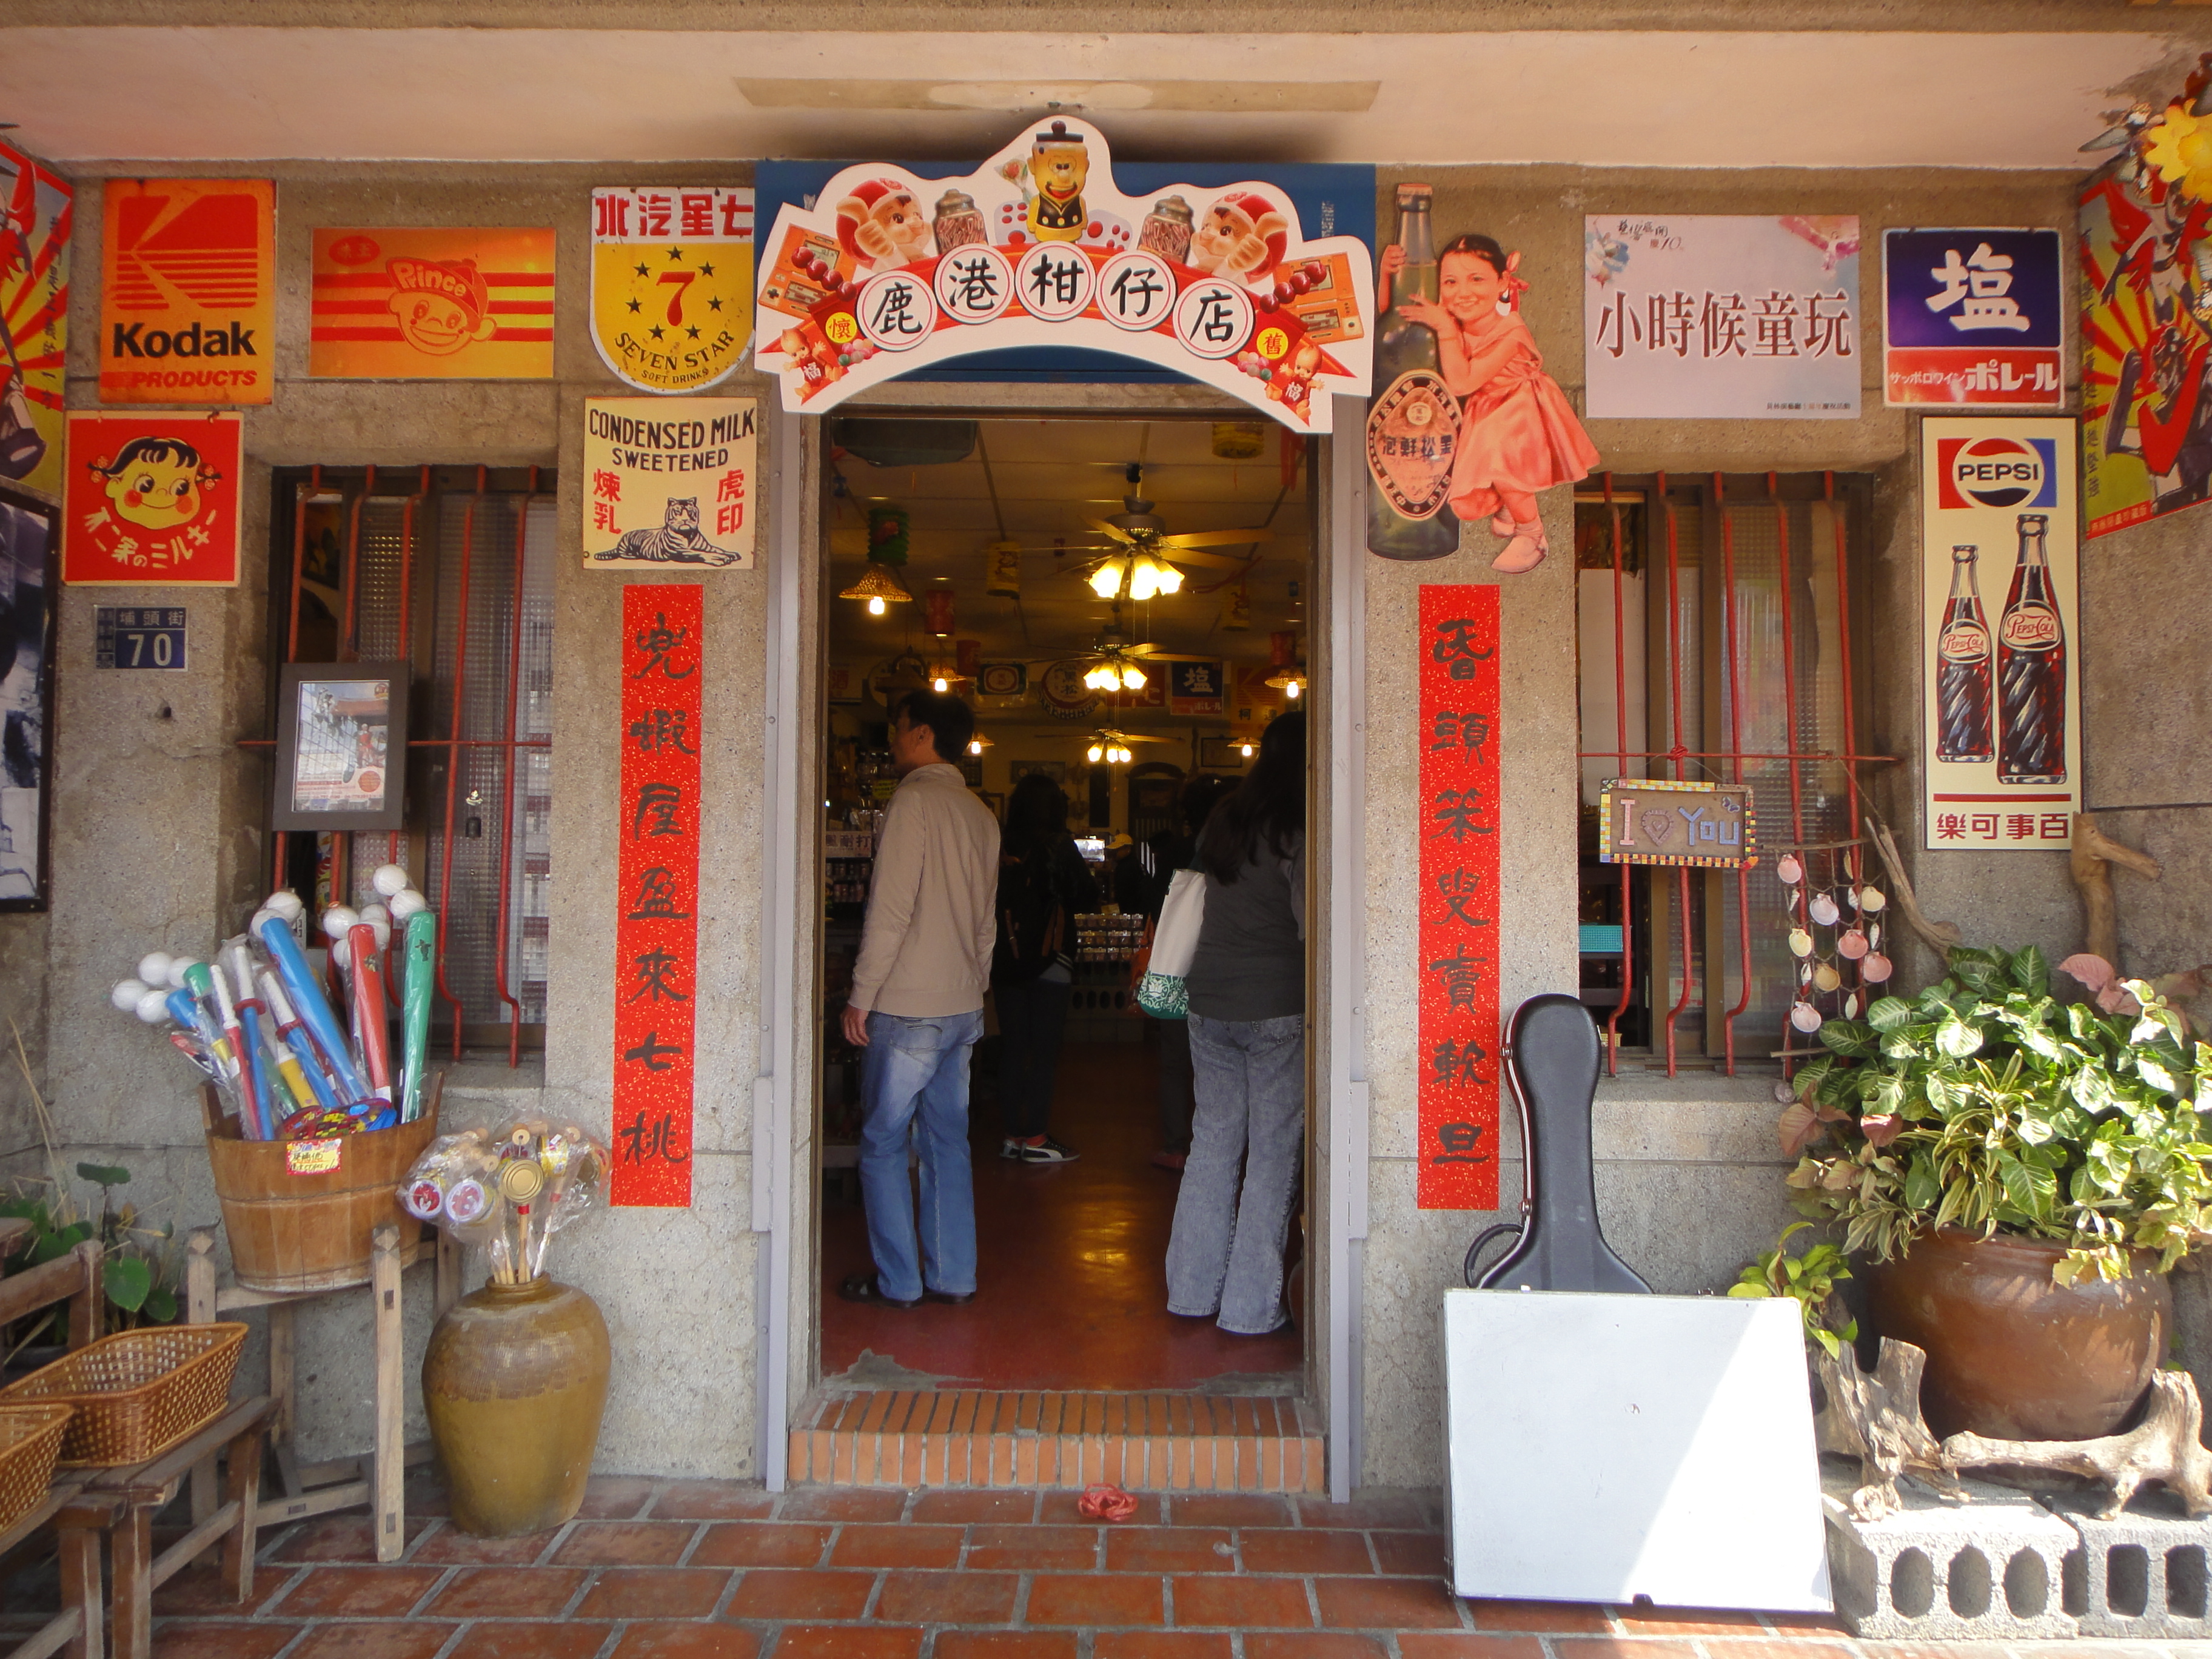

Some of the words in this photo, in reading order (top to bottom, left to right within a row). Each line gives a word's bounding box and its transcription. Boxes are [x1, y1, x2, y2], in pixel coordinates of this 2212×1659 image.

[392, 261, 467, 297] Prince
[1925, 242, 2031, 332] 塩
[655, 271, 696, 327] 7
[871, 252, 1235, 343] 鹿港柑仔店
[112, 321, 258, 358] Kodak
[828, 318, 852, 340] 懷
[1596, 289, 1852, 358] 小時候童玩
[615, 332, 677, 370] SEVEN
[684, 329, 735, 368] STAR
[1263, 332, 1284, 355] 舊
[132, 369, 258, 388] PRODUCTS
[641, 369, 668, 383] SOFT
[672, 367, 709, 384] DRINKS
[1965, 358, 2059, 391] ポレール
[589, 408, 705, 449] CONDENSED
[711, 407, 756, 446] MILK
[612, 447, 729, 472] SWEETENED
[1958, 463, 2039, 481] PEPSI
[119, 610, 184, 626] 埔頭街
[127, 632, 172, 667] 70
[1182, 666, 1214, 693] 塩
[1619, 799, 1635, 845] I
